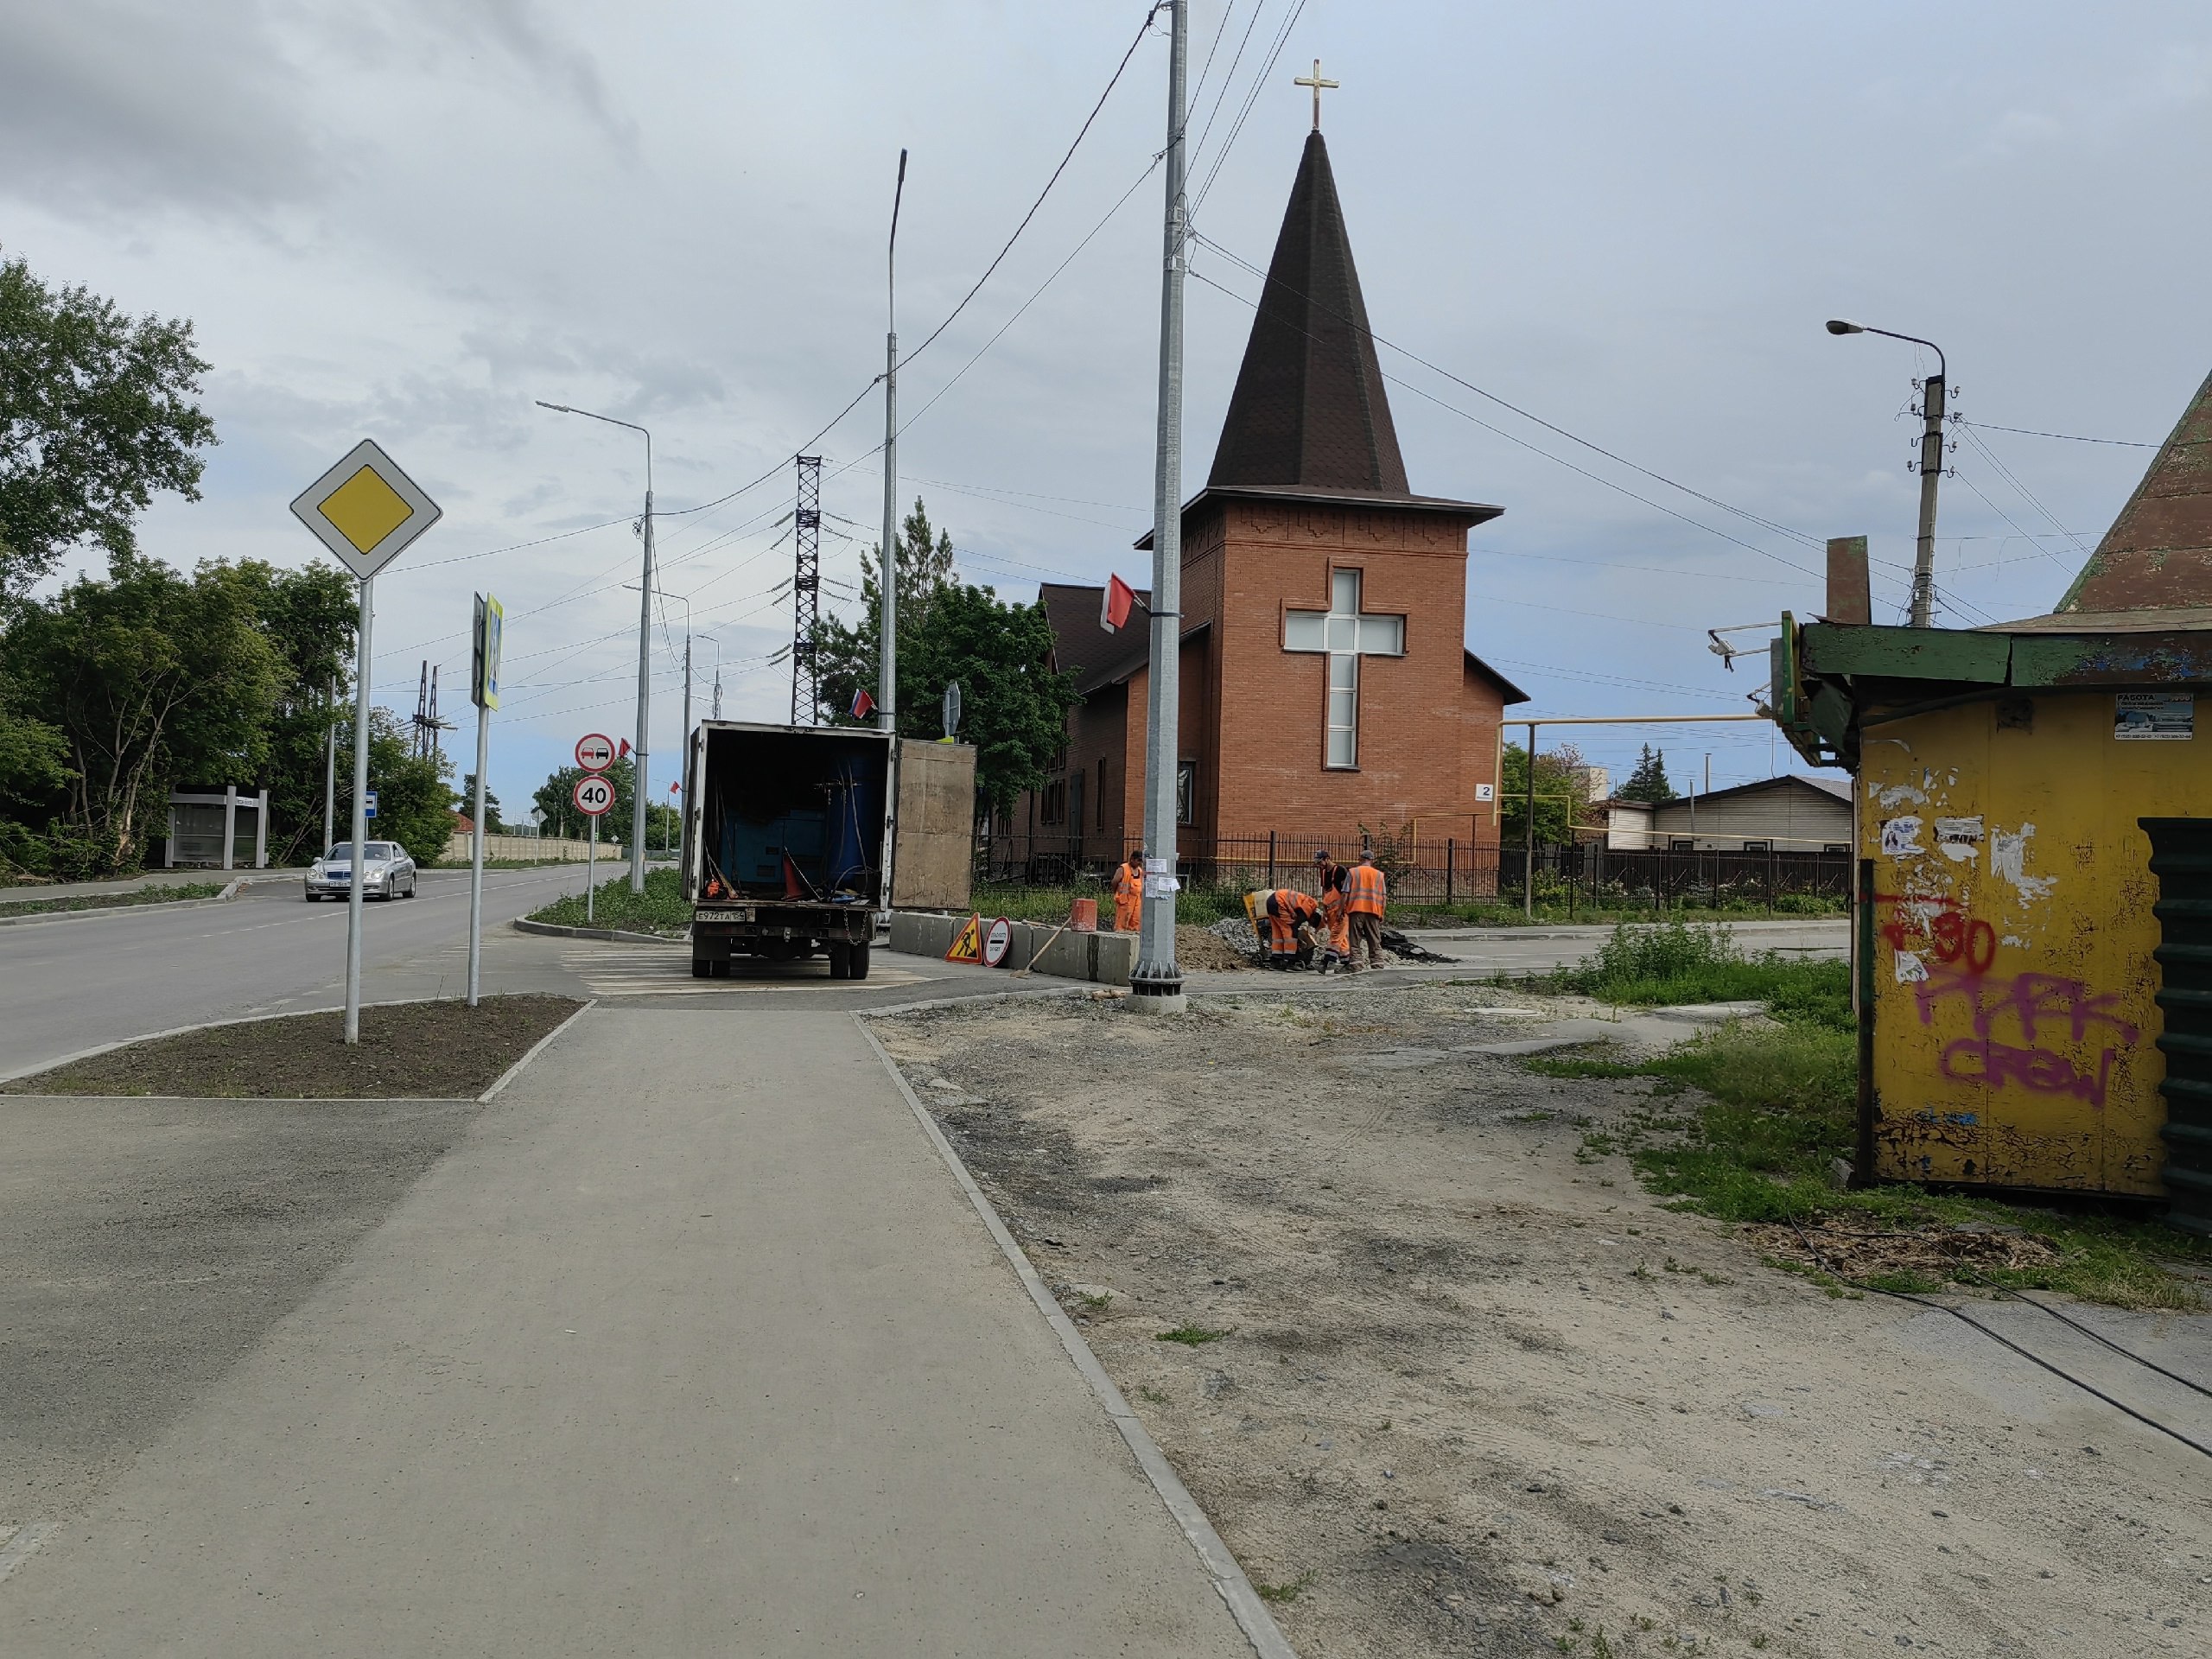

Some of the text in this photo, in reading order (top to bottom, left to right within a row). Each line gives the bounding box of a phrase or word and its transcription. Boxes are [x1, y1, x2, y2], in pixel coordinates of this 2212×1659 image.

[582, 787, 607, 804] 40
[1483, 786, 1491, 796] 2
[698, 912, 730, 920] Е972ТА
